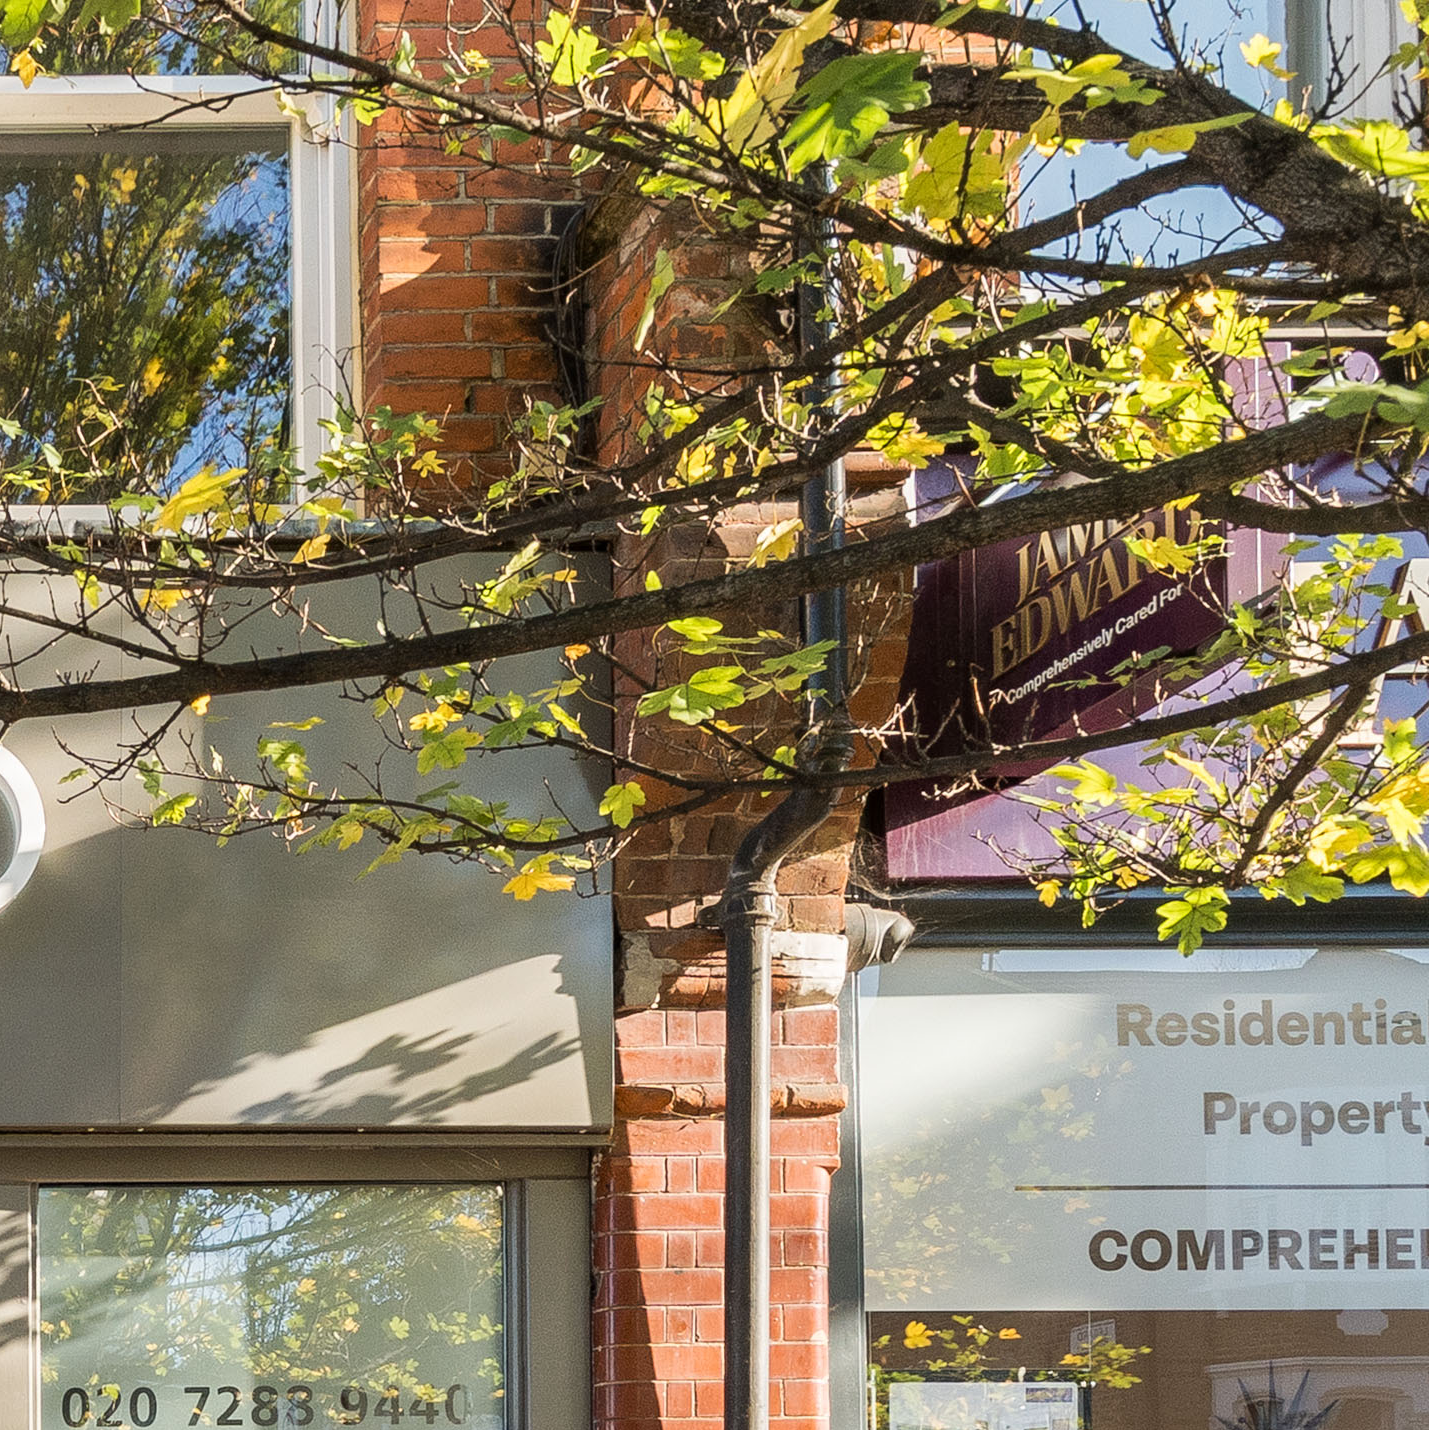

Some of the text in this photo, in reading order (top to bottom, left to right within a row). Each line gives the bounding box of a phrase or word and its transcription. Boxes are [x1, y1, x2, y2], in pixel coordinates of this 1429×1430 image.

[1008, 583, 1184, 705] Comprehensively Cared For
[1116, 999, 1429, 1047] Residentia
[1088, 1229, 1429, 1272] COMPREHE
[61, 1387, 157, 1429] 020
[340, 1384, 472, 1428] 9440
